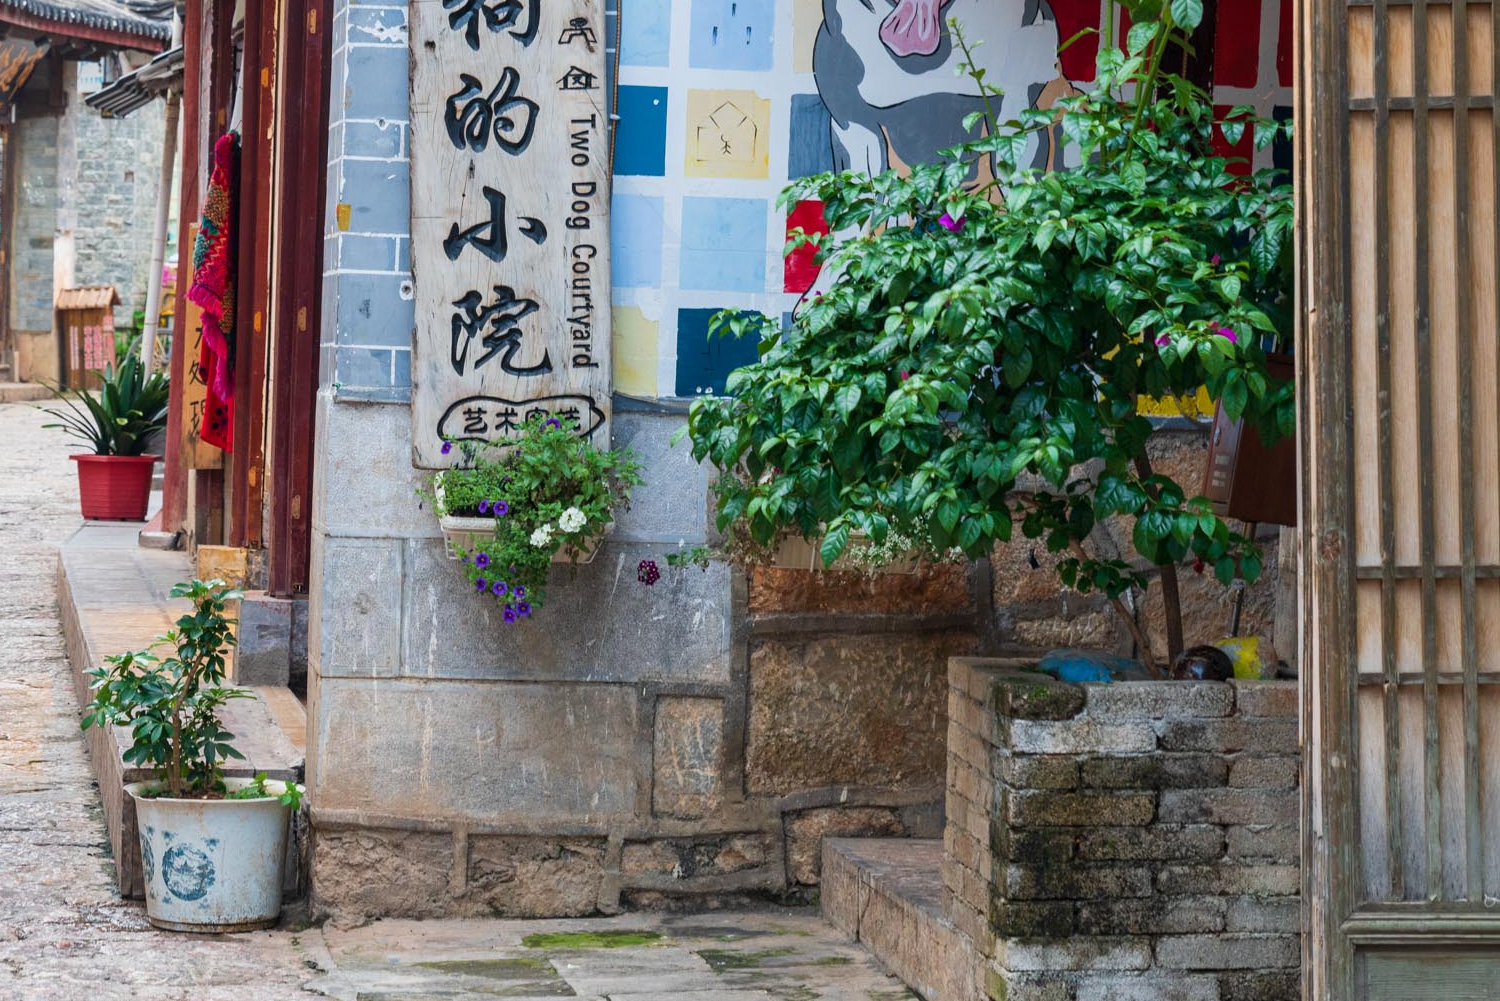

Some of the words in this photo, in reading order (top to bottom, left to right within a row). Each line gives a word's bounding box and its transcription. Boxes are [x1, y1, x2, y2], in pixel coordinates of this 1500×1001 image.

[570, 113, 596, 167] Two
[565, 181, 597, 230] Dog
[565, 243, 598, 369] Courtyard
